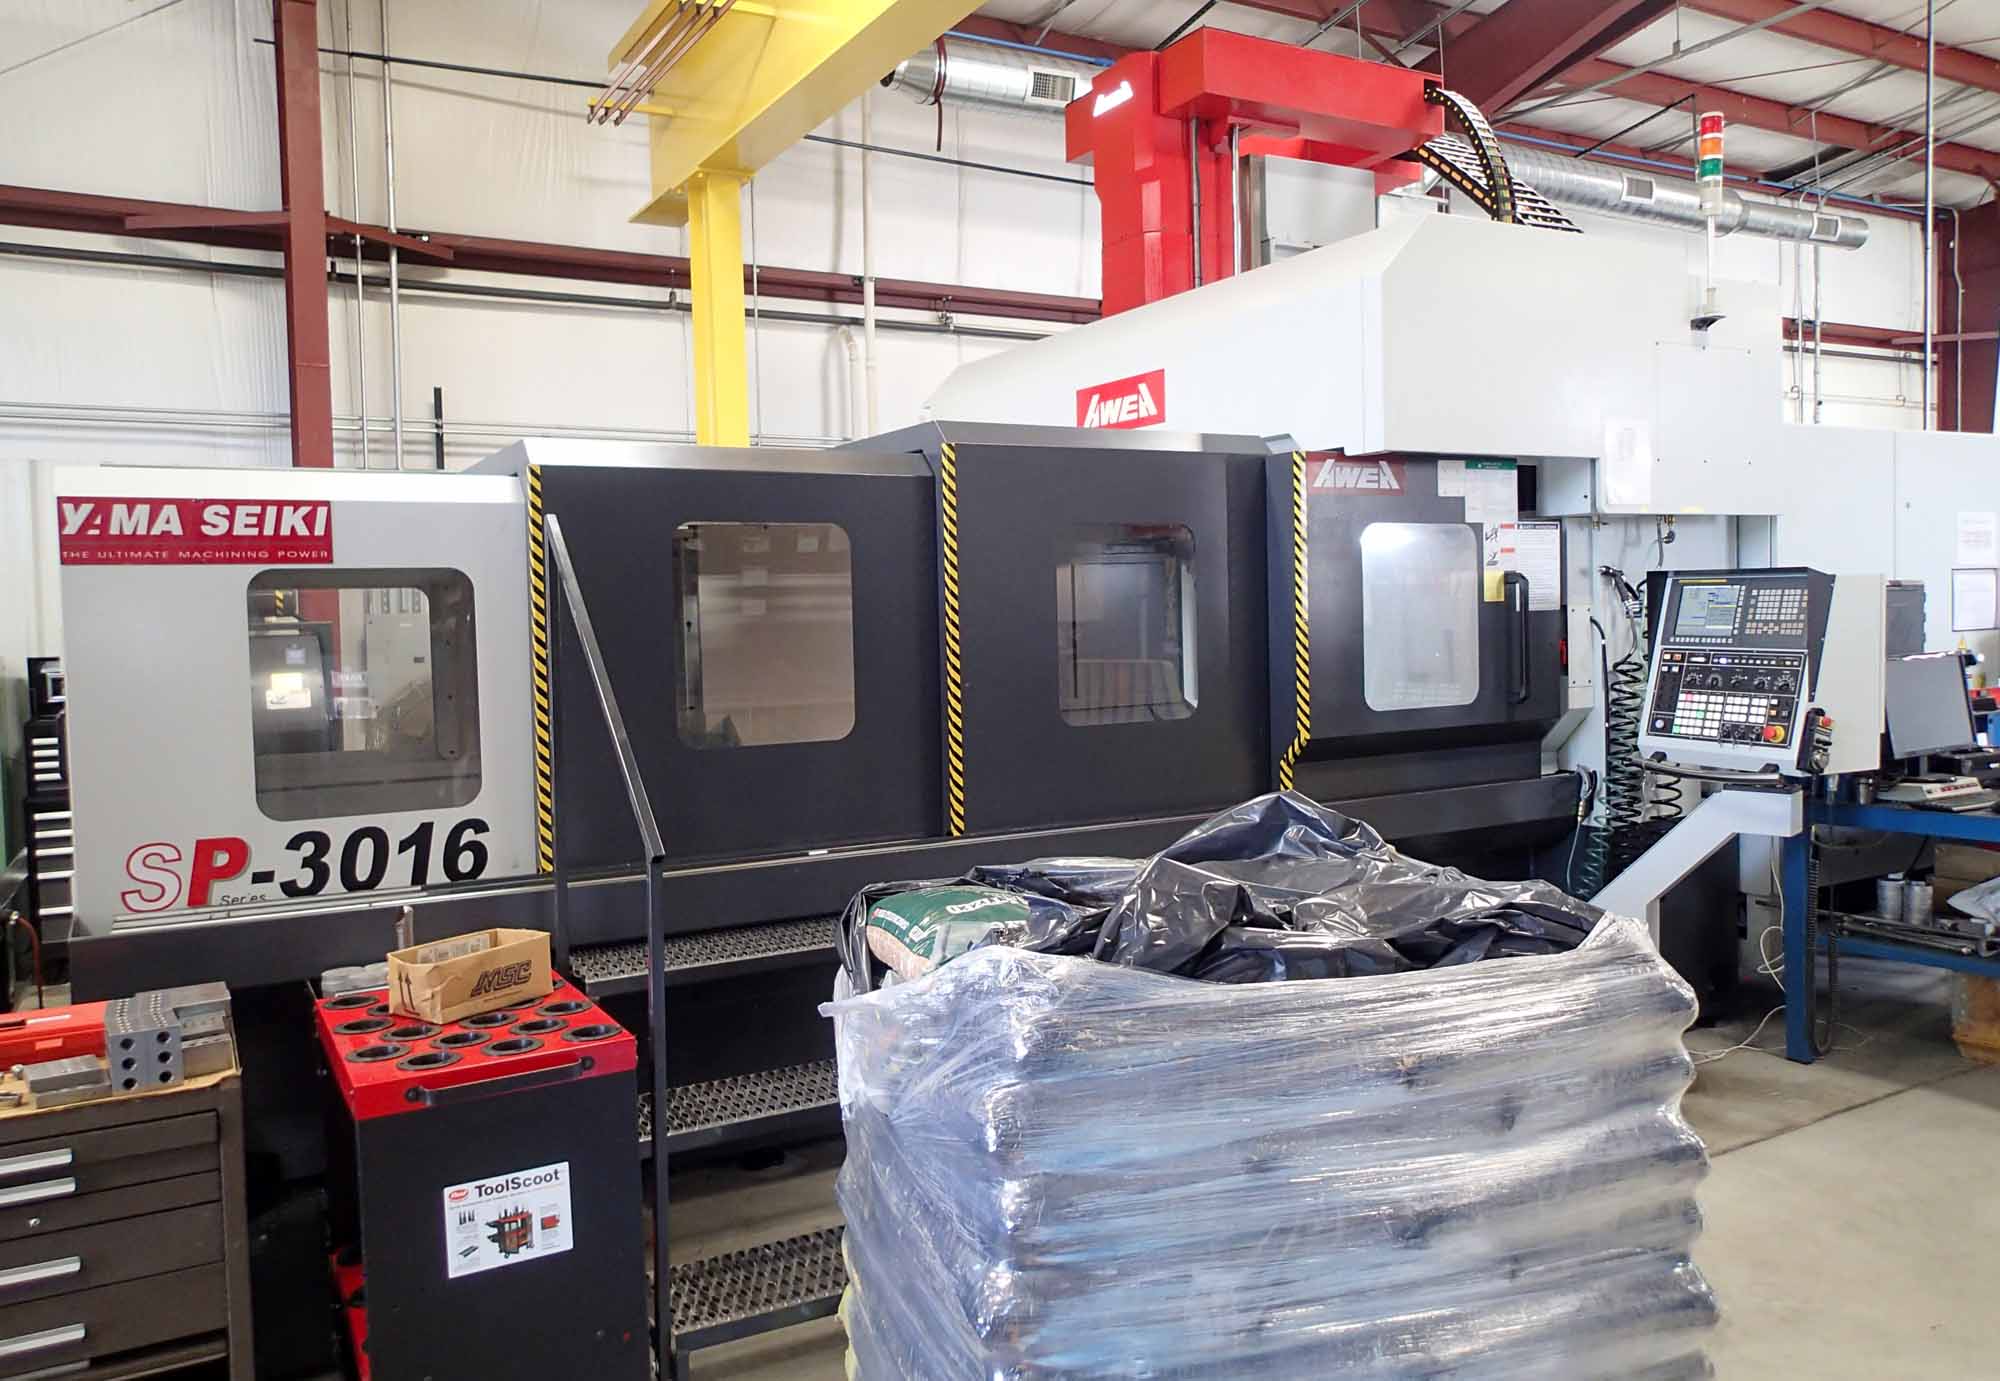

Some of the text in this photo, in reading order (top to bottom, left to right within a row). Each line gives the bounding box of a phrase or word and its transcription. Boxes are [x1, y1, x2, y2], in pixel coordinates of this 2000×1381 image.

[1083, 383, 1158, 428] AWEA
[1312, 459, 1401, 490] AWEA
[200, 504, 329, 537] SEIKI
[62, 550, 329, 559] THE ULTIMATE MACHINING POWER
[120, 818, 491, 913] SP-3016
[221, 893, 267, 905] Seres
[470, 960, 533, 998] MSC
[474, 1169, 561, 1198] ToolScoot
